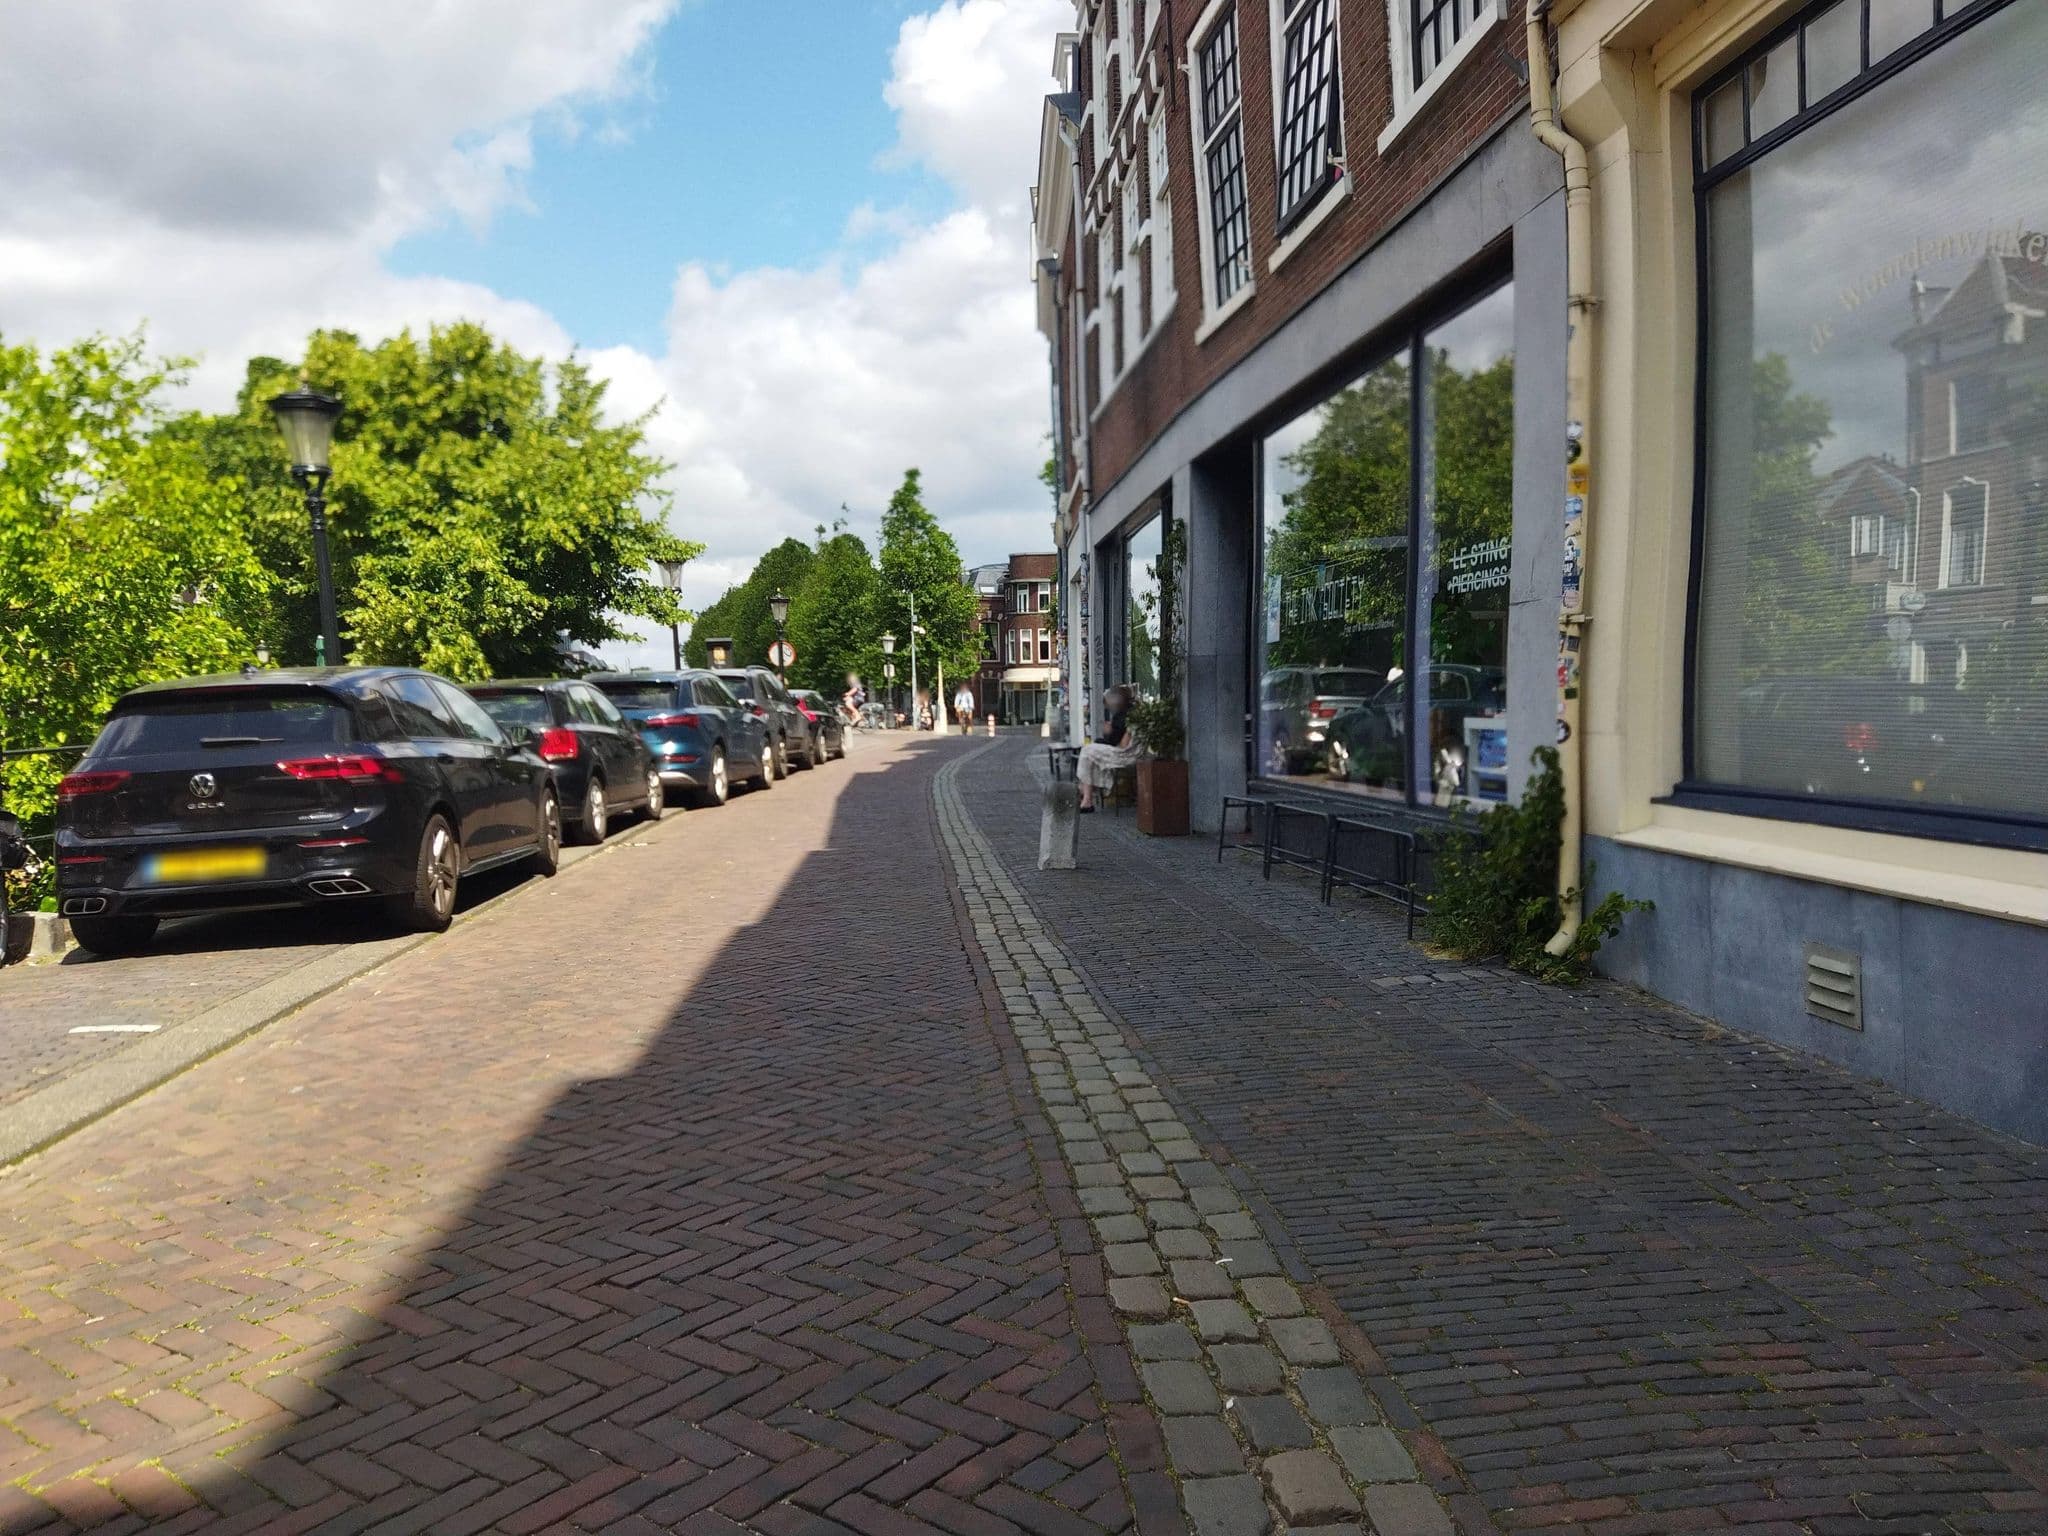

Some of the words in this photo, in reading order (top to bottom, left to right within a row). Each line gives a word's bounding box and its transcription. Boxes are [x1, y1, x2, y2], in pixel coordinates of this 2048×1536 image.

[1453, 546, 1467, 570] LE
[1470, 536, 1508, 567] STING
[1451, 565, 1508, 594] PIERCINGS
[187, 801, 225, 810] GOLF
